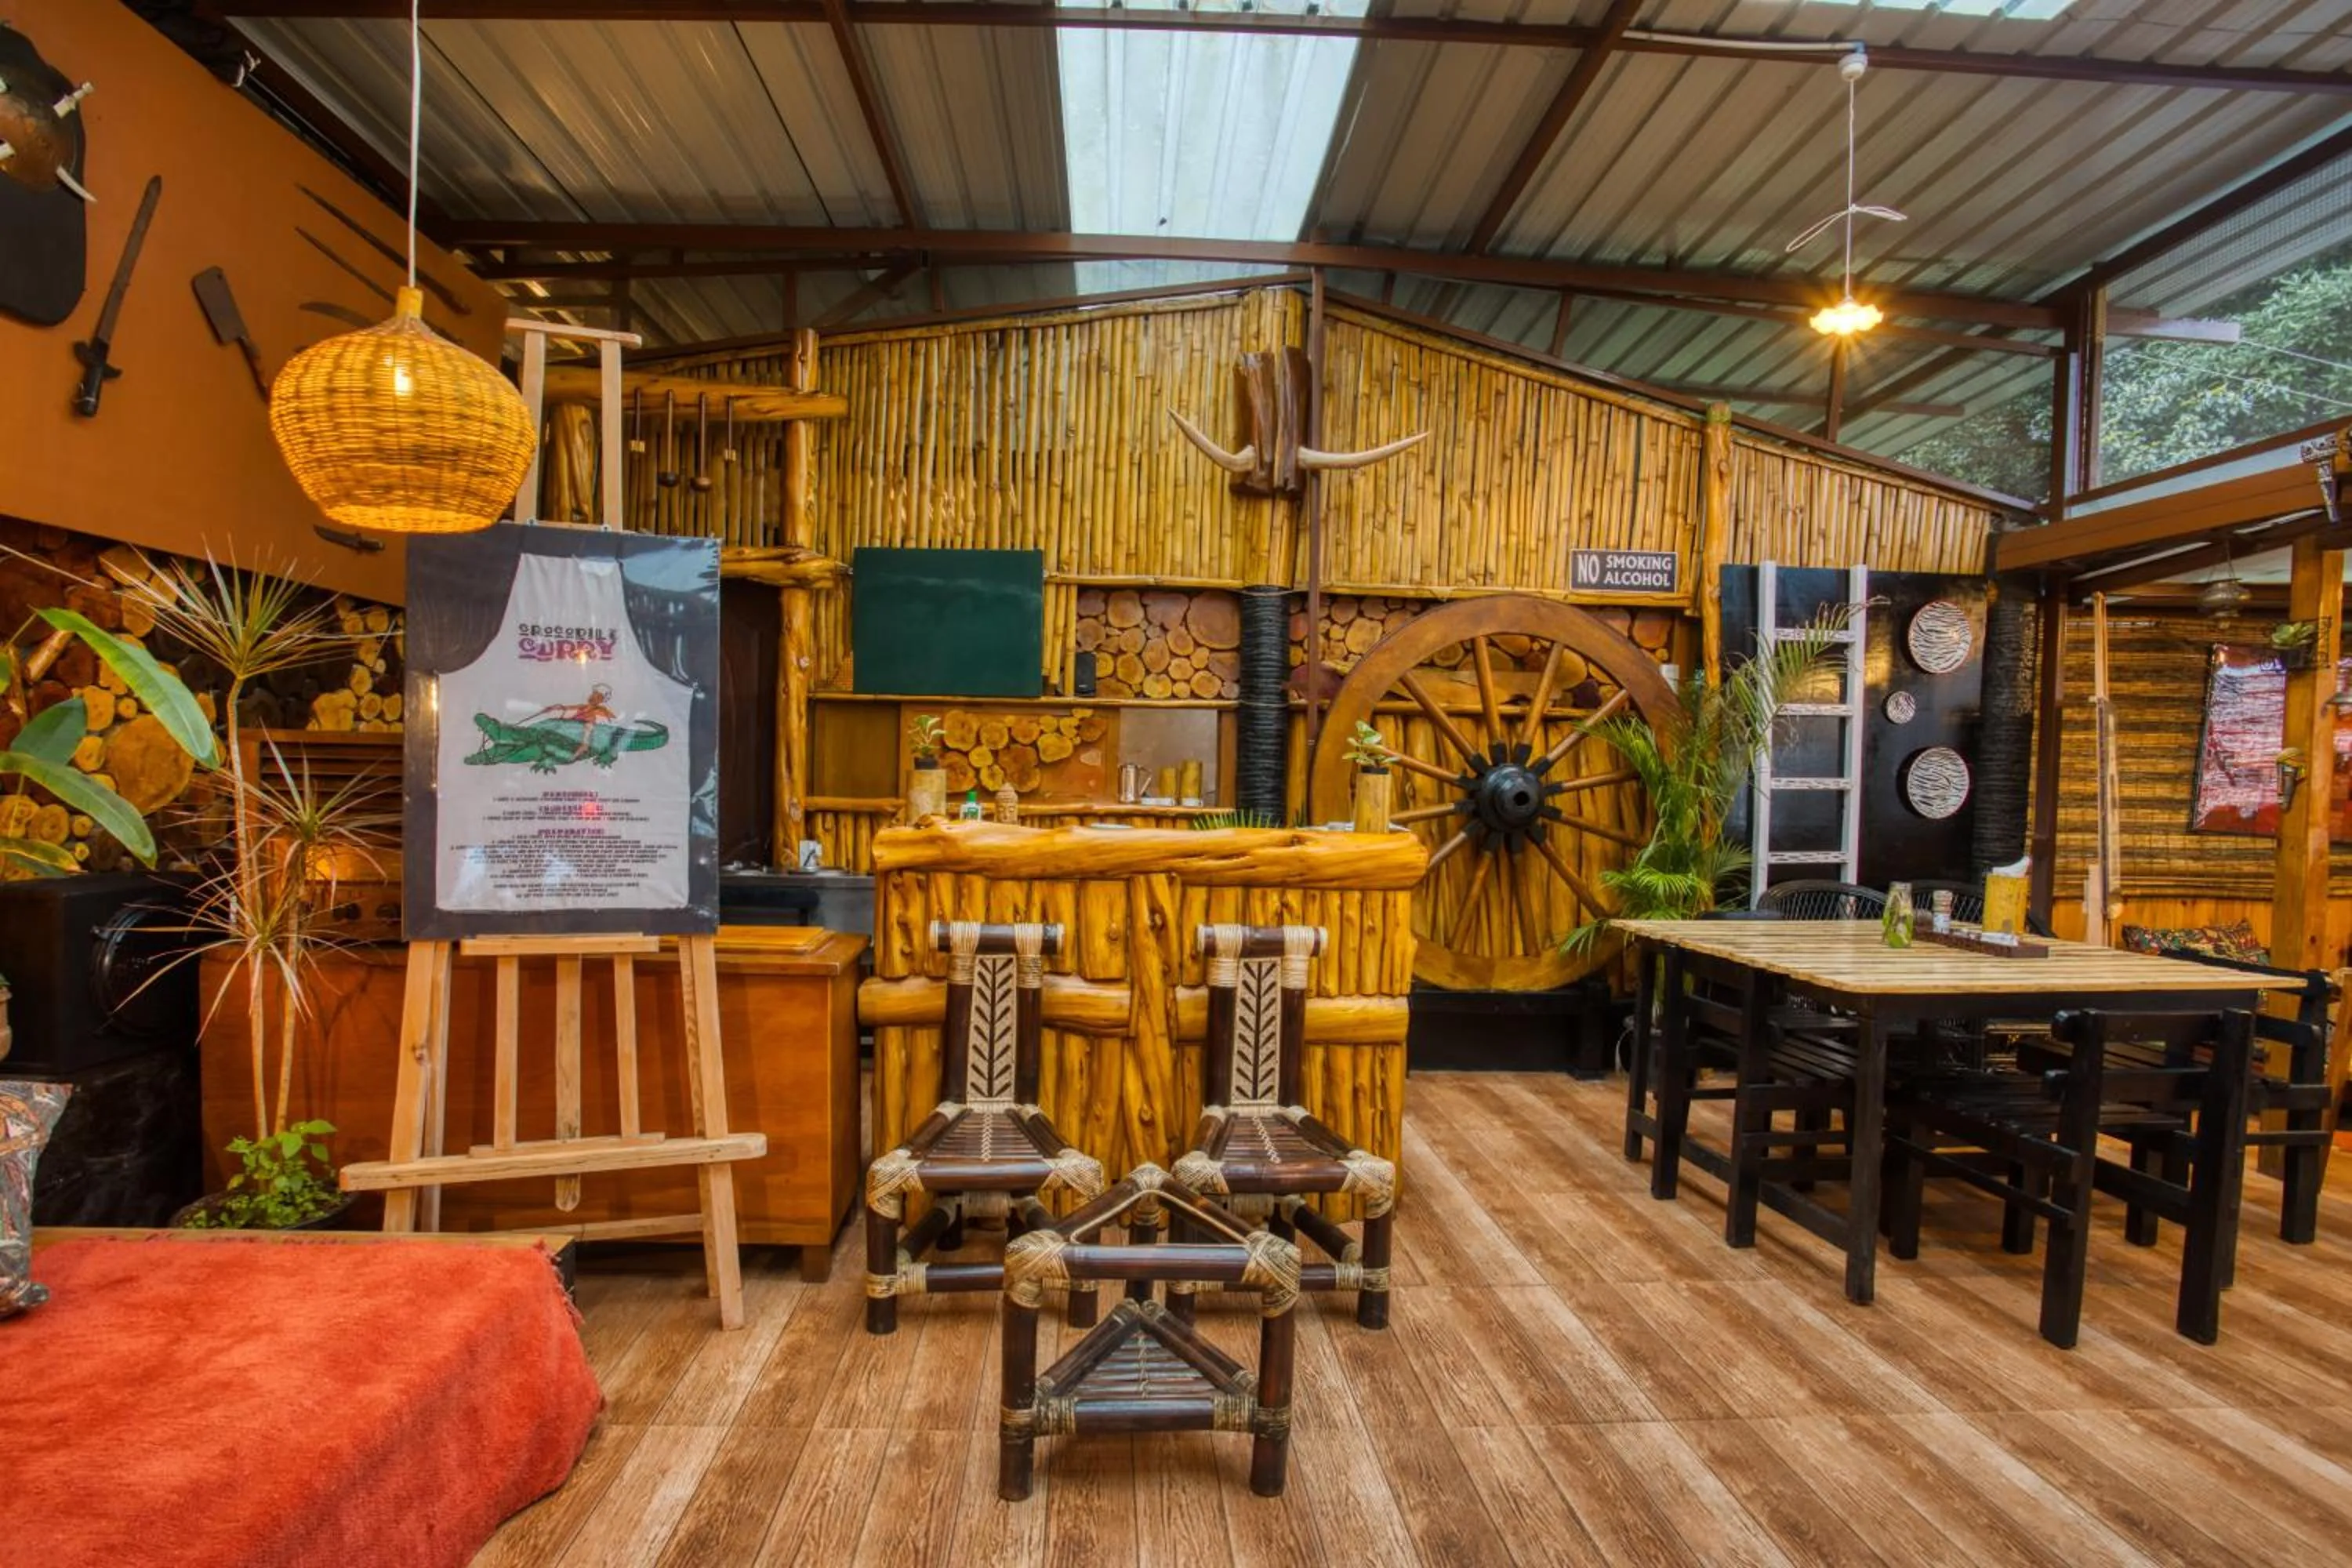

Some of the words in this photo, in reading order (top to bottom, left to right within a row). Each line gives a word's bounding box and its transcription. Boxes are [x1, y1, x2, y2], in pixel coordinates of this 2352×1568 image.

[1577, 554, 1600, 584] NO
[1606, 554, 1671, 570] SMOKING
[1603, 572, 1671, 587] ALCOHOL
[518, 623, 618, 640] CROCODILE
[518, 637, 616, 662] CURRY
